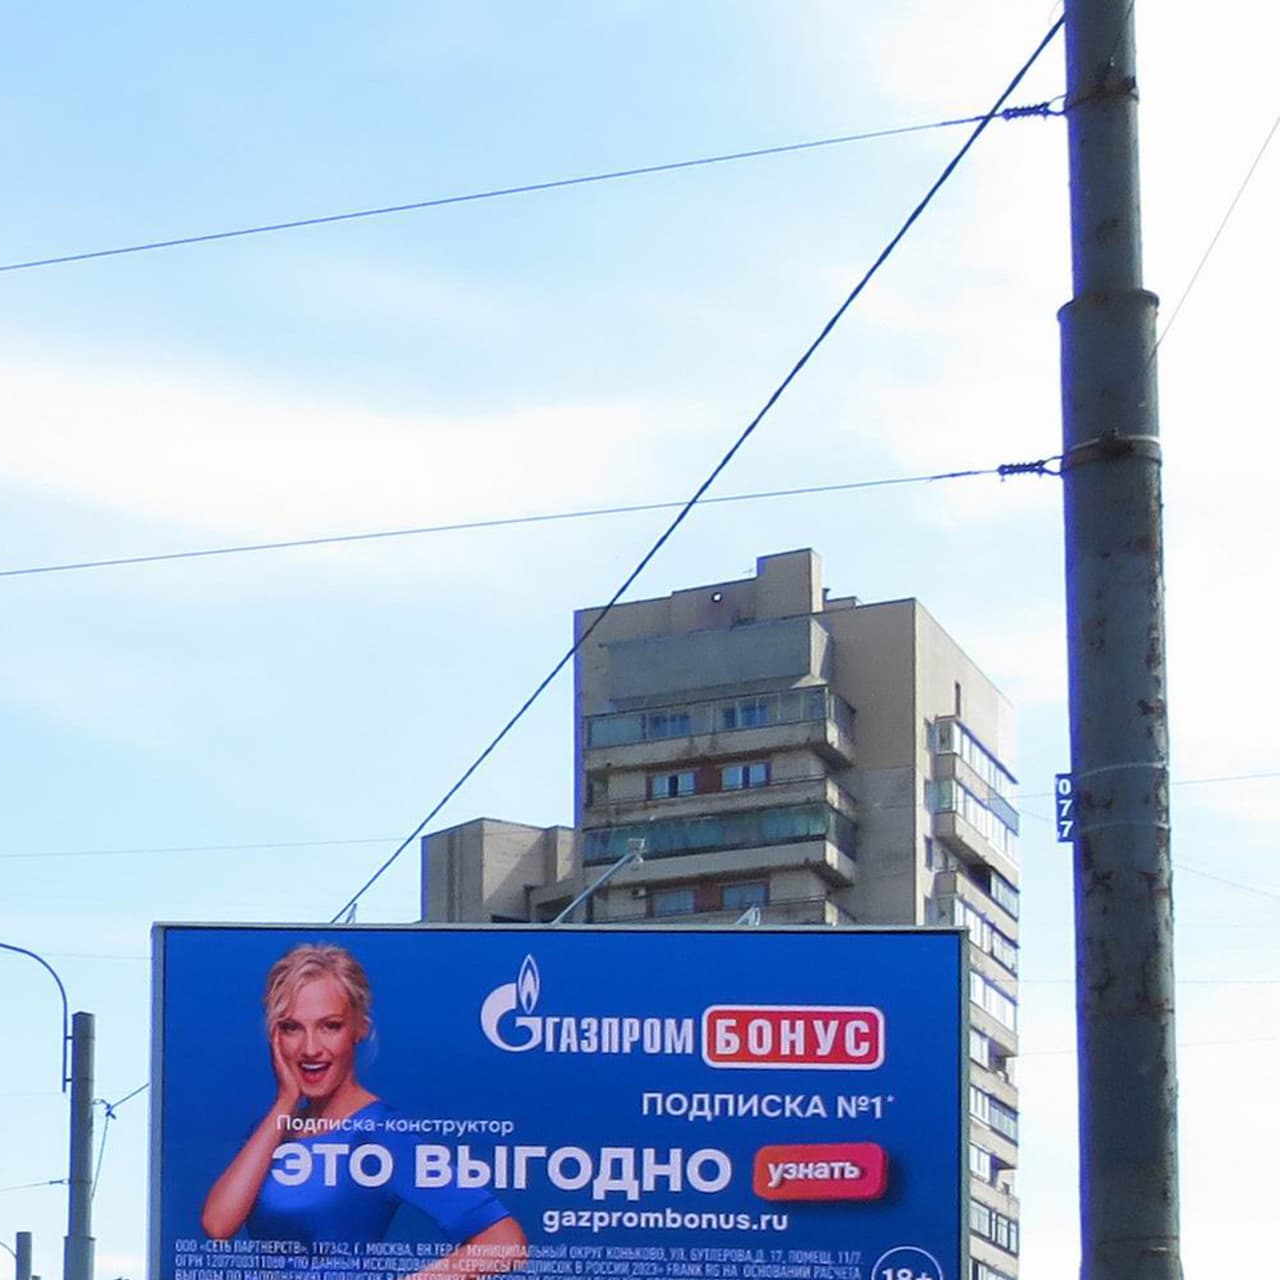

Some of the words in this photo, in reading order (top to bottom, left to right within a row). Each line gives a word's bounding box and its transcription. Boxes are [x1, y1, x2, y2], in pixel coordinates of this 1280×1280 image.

[1058, 779, 1073, 838] 077
[544, 1016, 694, 1054] ГАЗПРОМ
[715, 1018, 870, 1057] БОНУС
[642, 1093, 826, 1121] ПОДПИСКА
[276, 1114, 515, 1138] Подписка-конструктор
[272, 1142, 393, 1188] ЭТО
[415, 1144, 732, 1200] ВЫГОДНО
[767, 1161, 861, 1188] узнать
[543, 1208, 788, 1233] gazprombonus.ru
[175, 1239, 197, 1252] ООО
[175, 1254, 203, 1268] ОГРН
[513, 1260, 573, 1275] ПОДПИСОК
[586, 1262, 630, 1276] РОССИИ
[666, 1263, 704, 1277] FRANK
